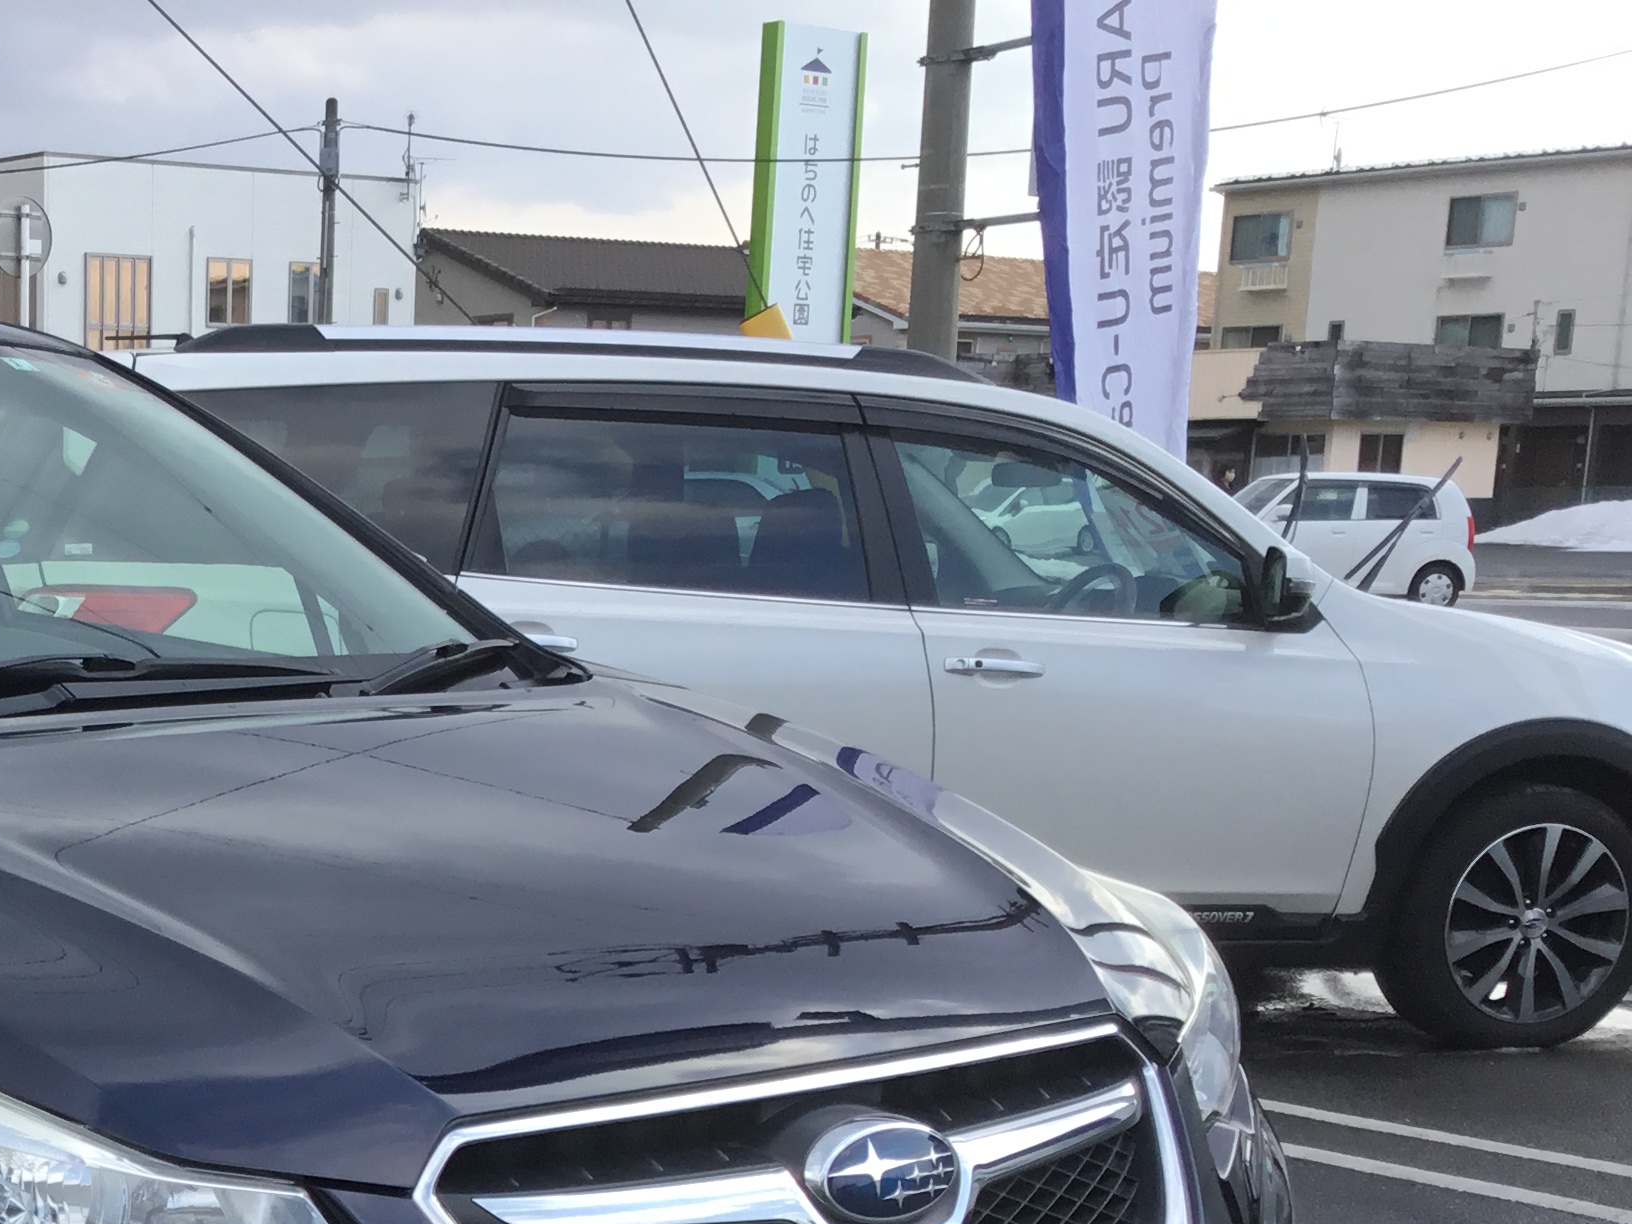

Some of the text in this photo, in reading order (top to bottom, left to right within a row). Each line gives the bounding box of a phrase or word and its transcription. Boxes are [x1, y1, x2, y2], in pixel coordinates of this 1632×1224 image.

[793, 133, 820, 326] はちのへ住宅公園
